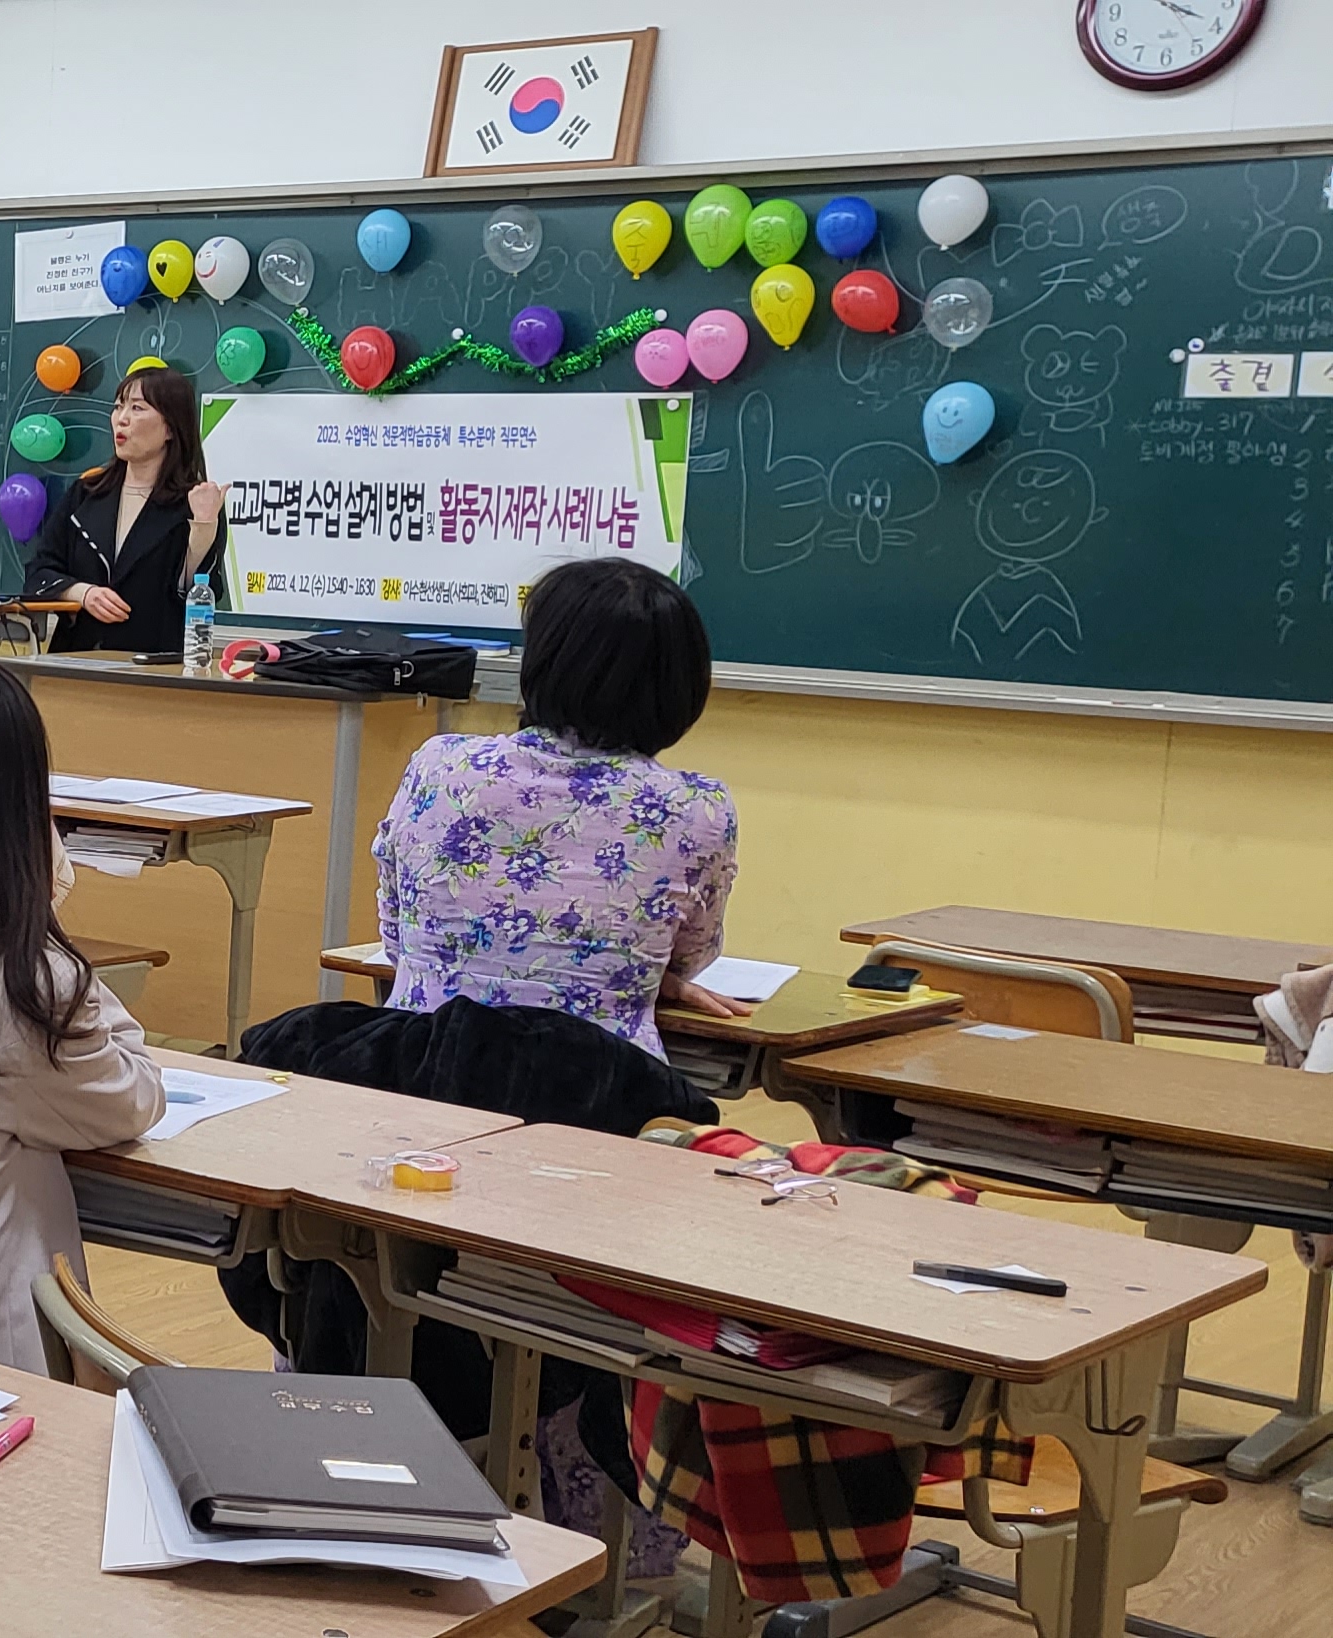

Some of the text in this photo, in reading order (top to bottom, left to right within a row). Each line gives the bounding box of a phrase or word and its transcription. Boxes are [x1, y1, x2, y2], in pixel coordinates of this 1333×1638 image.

[1109, 4, 1121, 22] 9
[1209, 17, 1223, 34] 4
[1114, 28, 1127, 46] 8
[1134, 45, 1145, 62] 7
[1191, 38, 1203, 56] 5
[1160, 48, 1172, 66] 6
[1209, 359, 1273, 392] 출결
[317, 425, 537, 448] 2023. 수업혁신 전문적학습공동체 특수분야 직무연수
[229, 480, 302, 536] 교과군별
[306, 481, 342, 538] 수업
[344, 481, 381, 539] 설계
[386, 483, 425, 542] 방법
[439, 479, 501, 545] 활동지
[502, 484, 547, 545] 제작
[548, 486, 594, 545] 사례
[596, 486, 639, 549] 나눔
[247, 572, 265, 593] 일시:
[382, 578, 401, 601] 강사:
